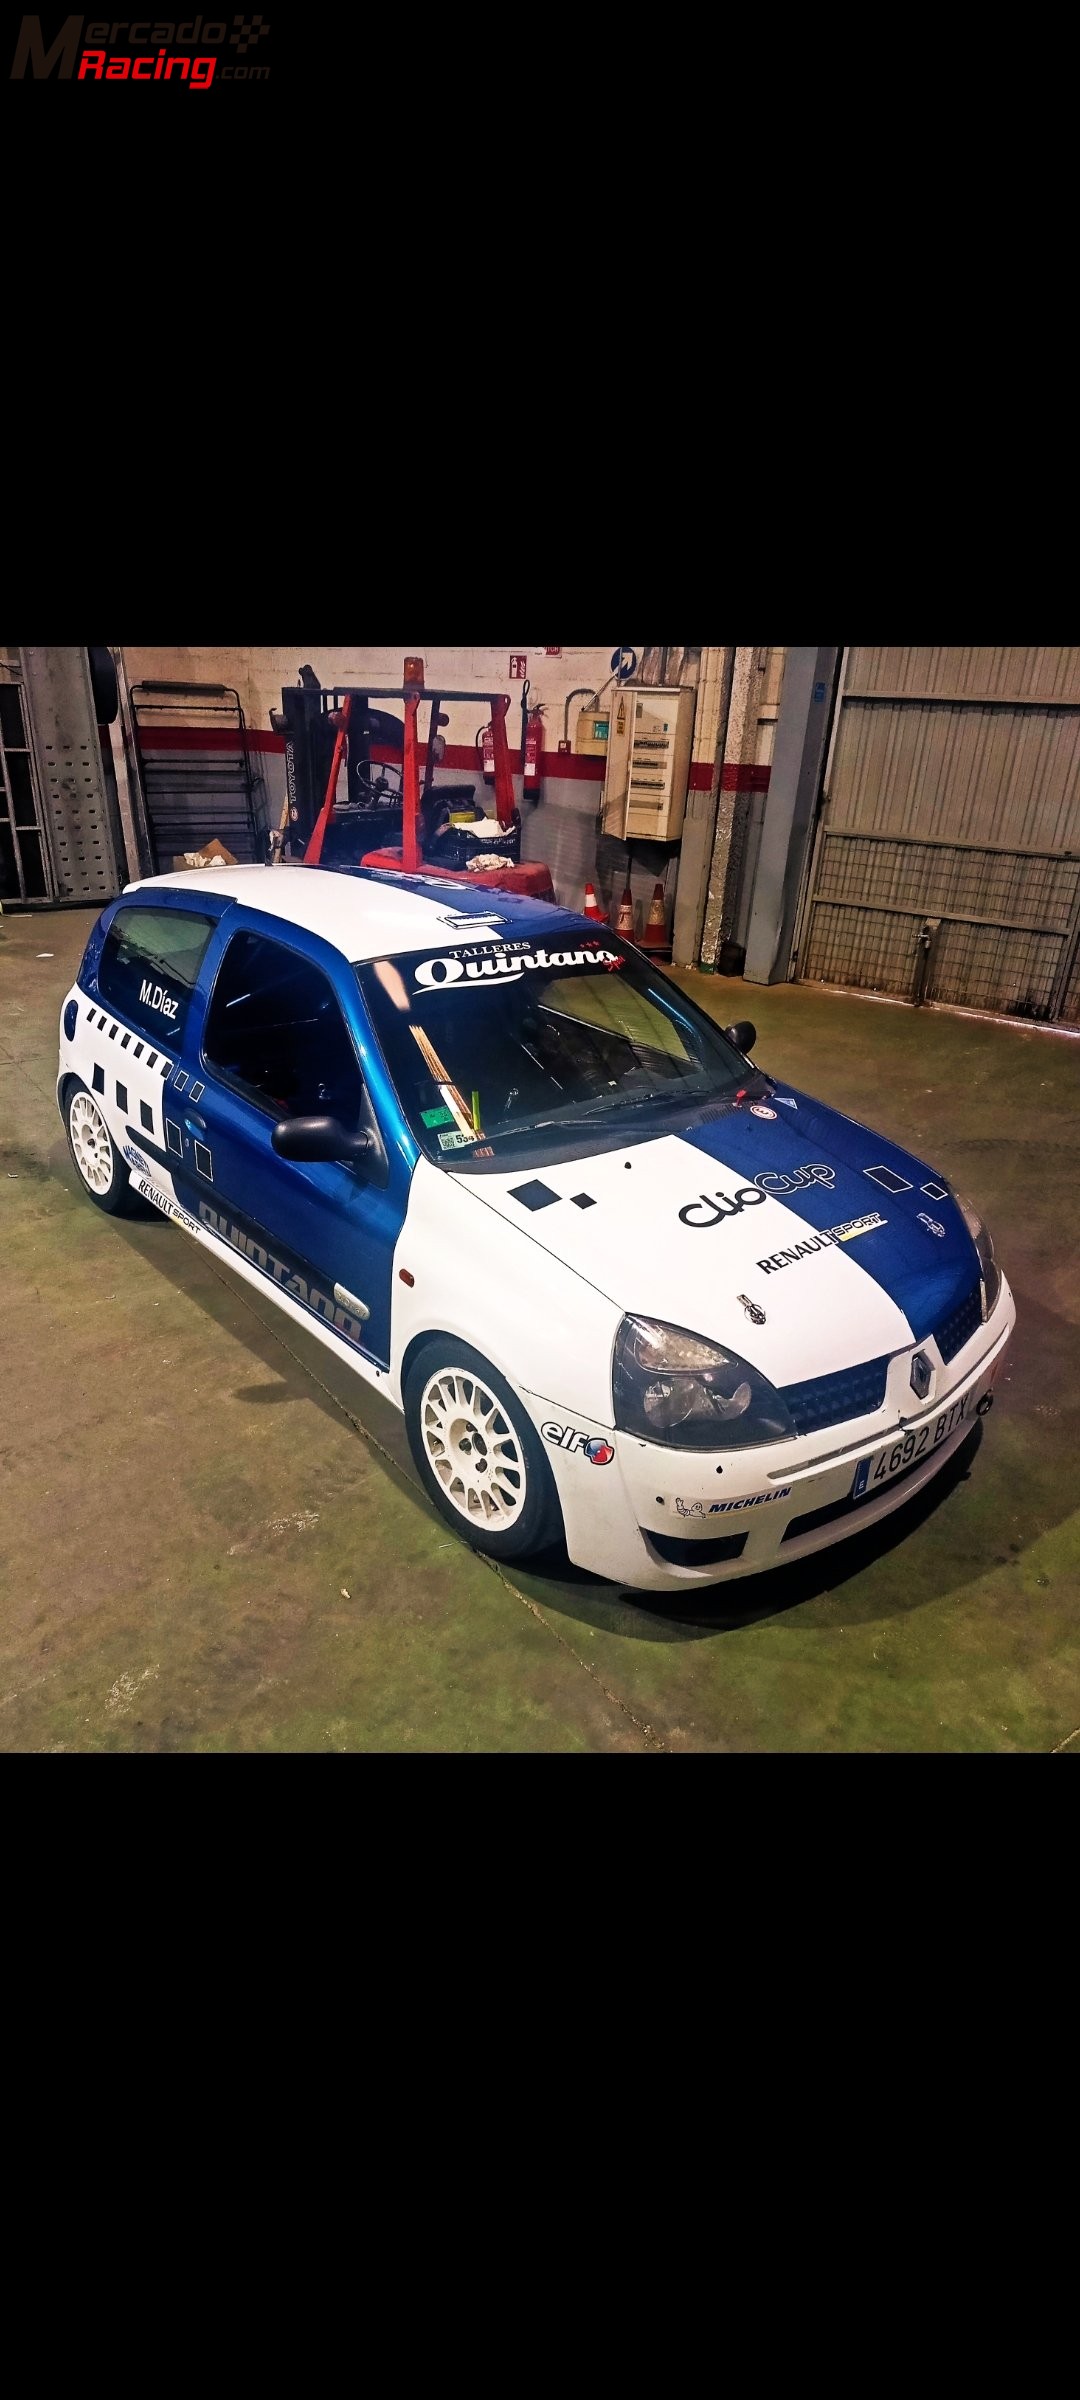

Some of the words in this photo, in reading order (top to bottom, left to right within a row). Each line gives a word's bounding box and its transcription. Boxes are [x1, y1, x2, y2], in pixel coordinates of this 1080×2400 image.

[286, 741, 297, 804] TOYOTA
[412, 949, 618, 996] Quintano
[449, 941, 531, 959] TALLERES
[138, 1179, 174, 1215] RENAULT
[172, 1208, 202, 1234] SPORT
[755, 1229, 838, 1275] RENAULT
[832, 1212, 881, 1237] SPORT
[541, 1421, 589, 1453] elf
[873, 1425, 930, 1481] 4692
[933, 1391, 970, 1444] BTX
[708, 1486, 792, 1513] MICHELIN
